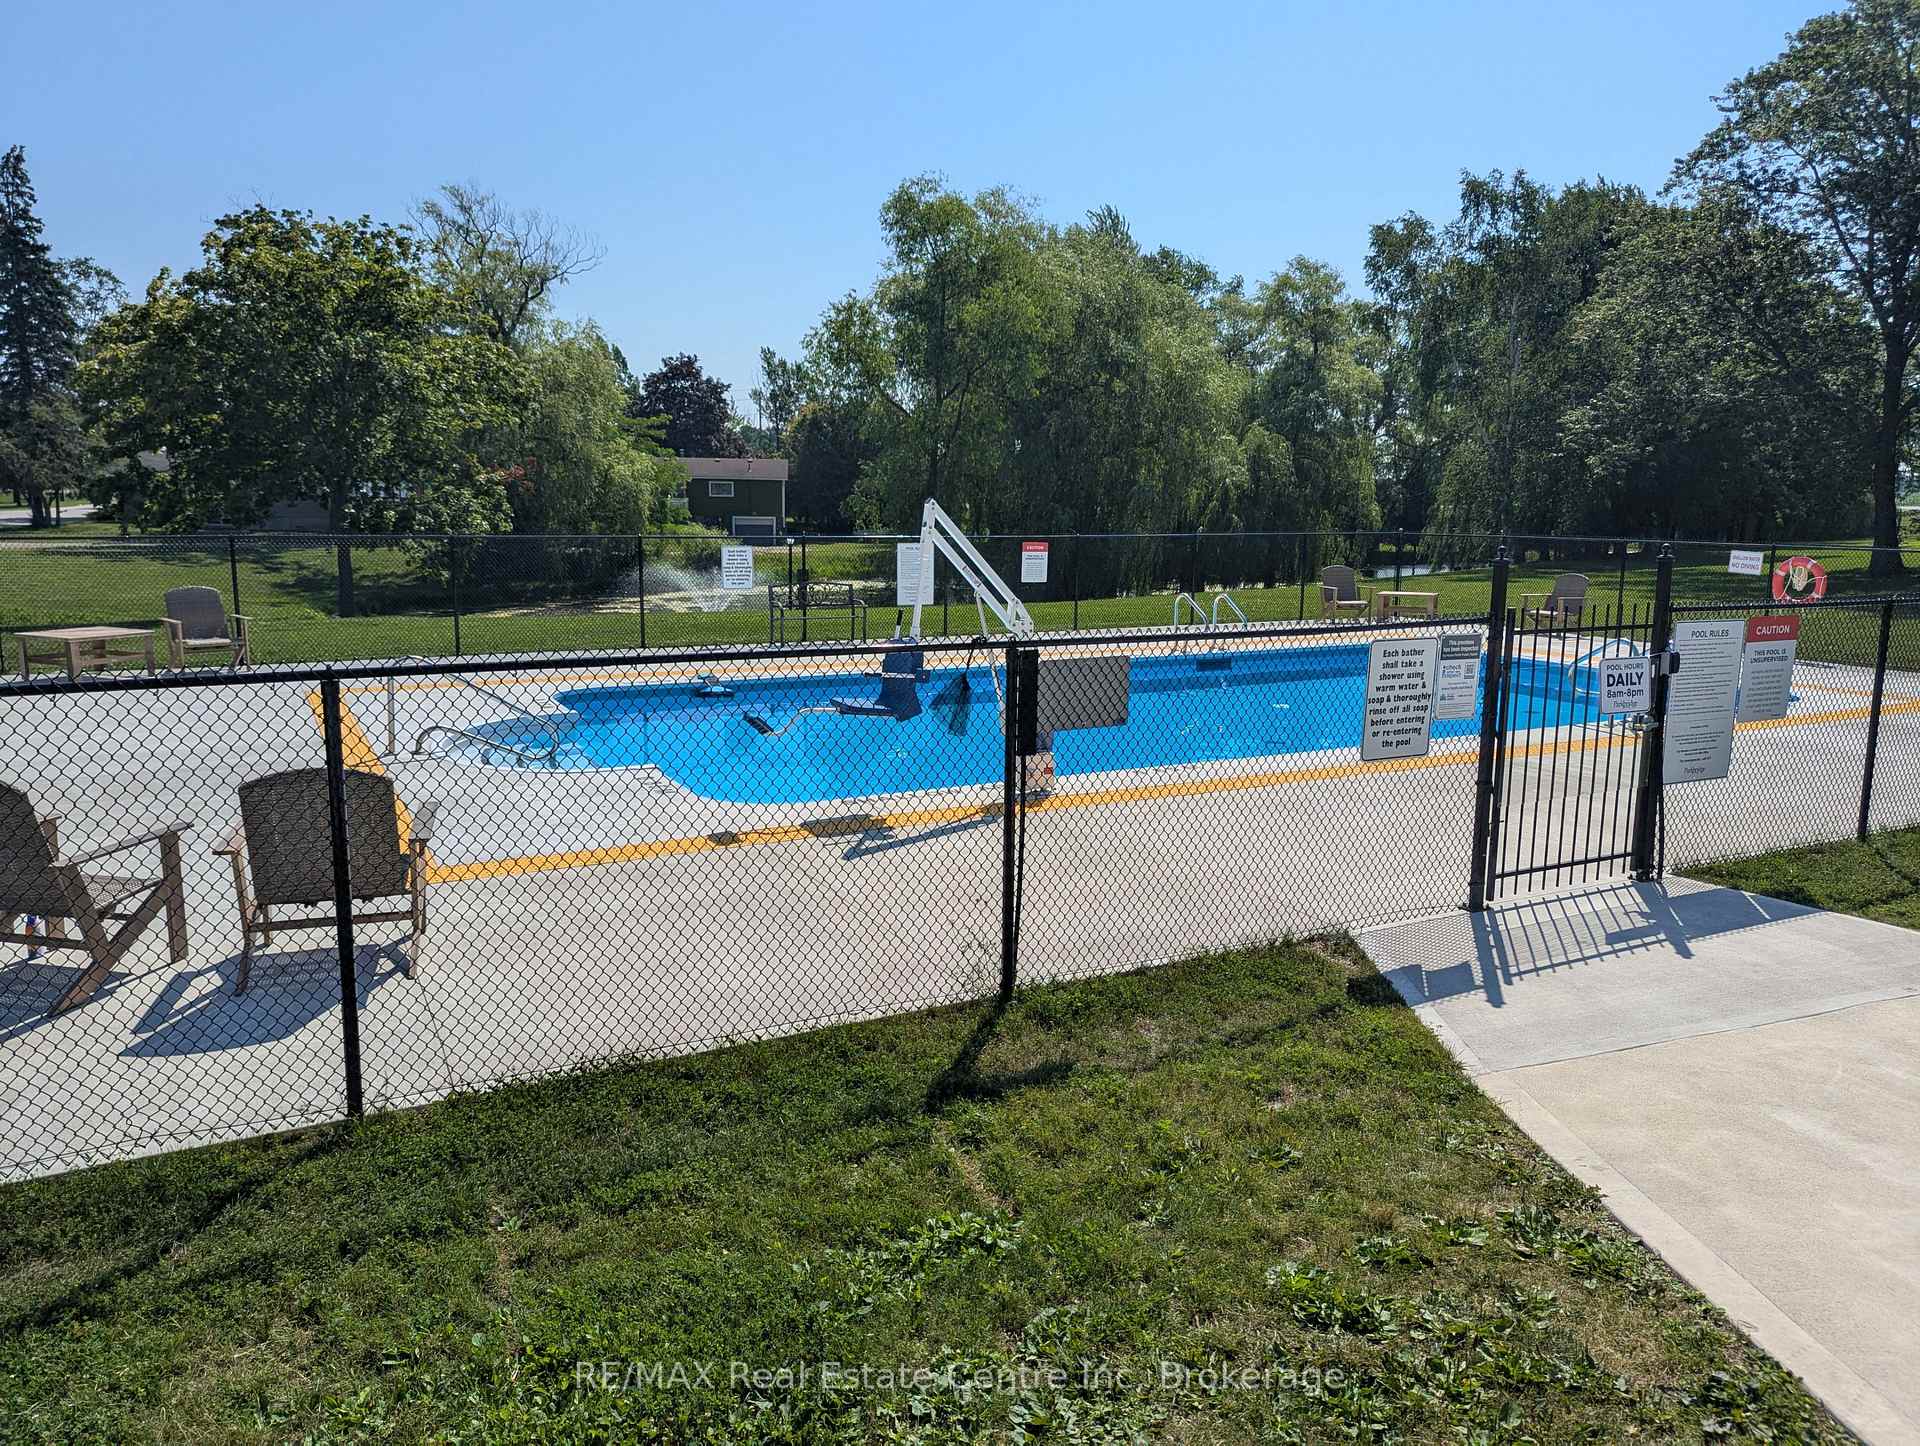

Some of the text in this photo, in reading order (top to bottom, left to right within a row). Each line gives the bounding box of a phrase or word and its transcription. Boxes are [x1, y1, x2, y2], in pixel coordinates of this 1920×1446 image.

[1756, 625, 1790, 635] CAUTION
[1383, 648, 1424, 658] Each bather
[1382, 661, 1398, 669] shall
[1407, 671, 1425, 680] using
[1607, 672, 1644, 687] DAILY
[1376, 684, 1395, 692] warm
[1399, 683, 1419, 691] water
[1607, 689, 1644, 698] 8am-8pm
[1368, 696, 1384, 706] soap
[1394, 692, 1431, 703] thoroughly
[1369, 704, 1428, 715] rinse off all soap
[1371, 716, 1425, 727] before entering
[1383, 727, 1422, 736] re-entering
[1382, 738, 1411, 749] the pool
